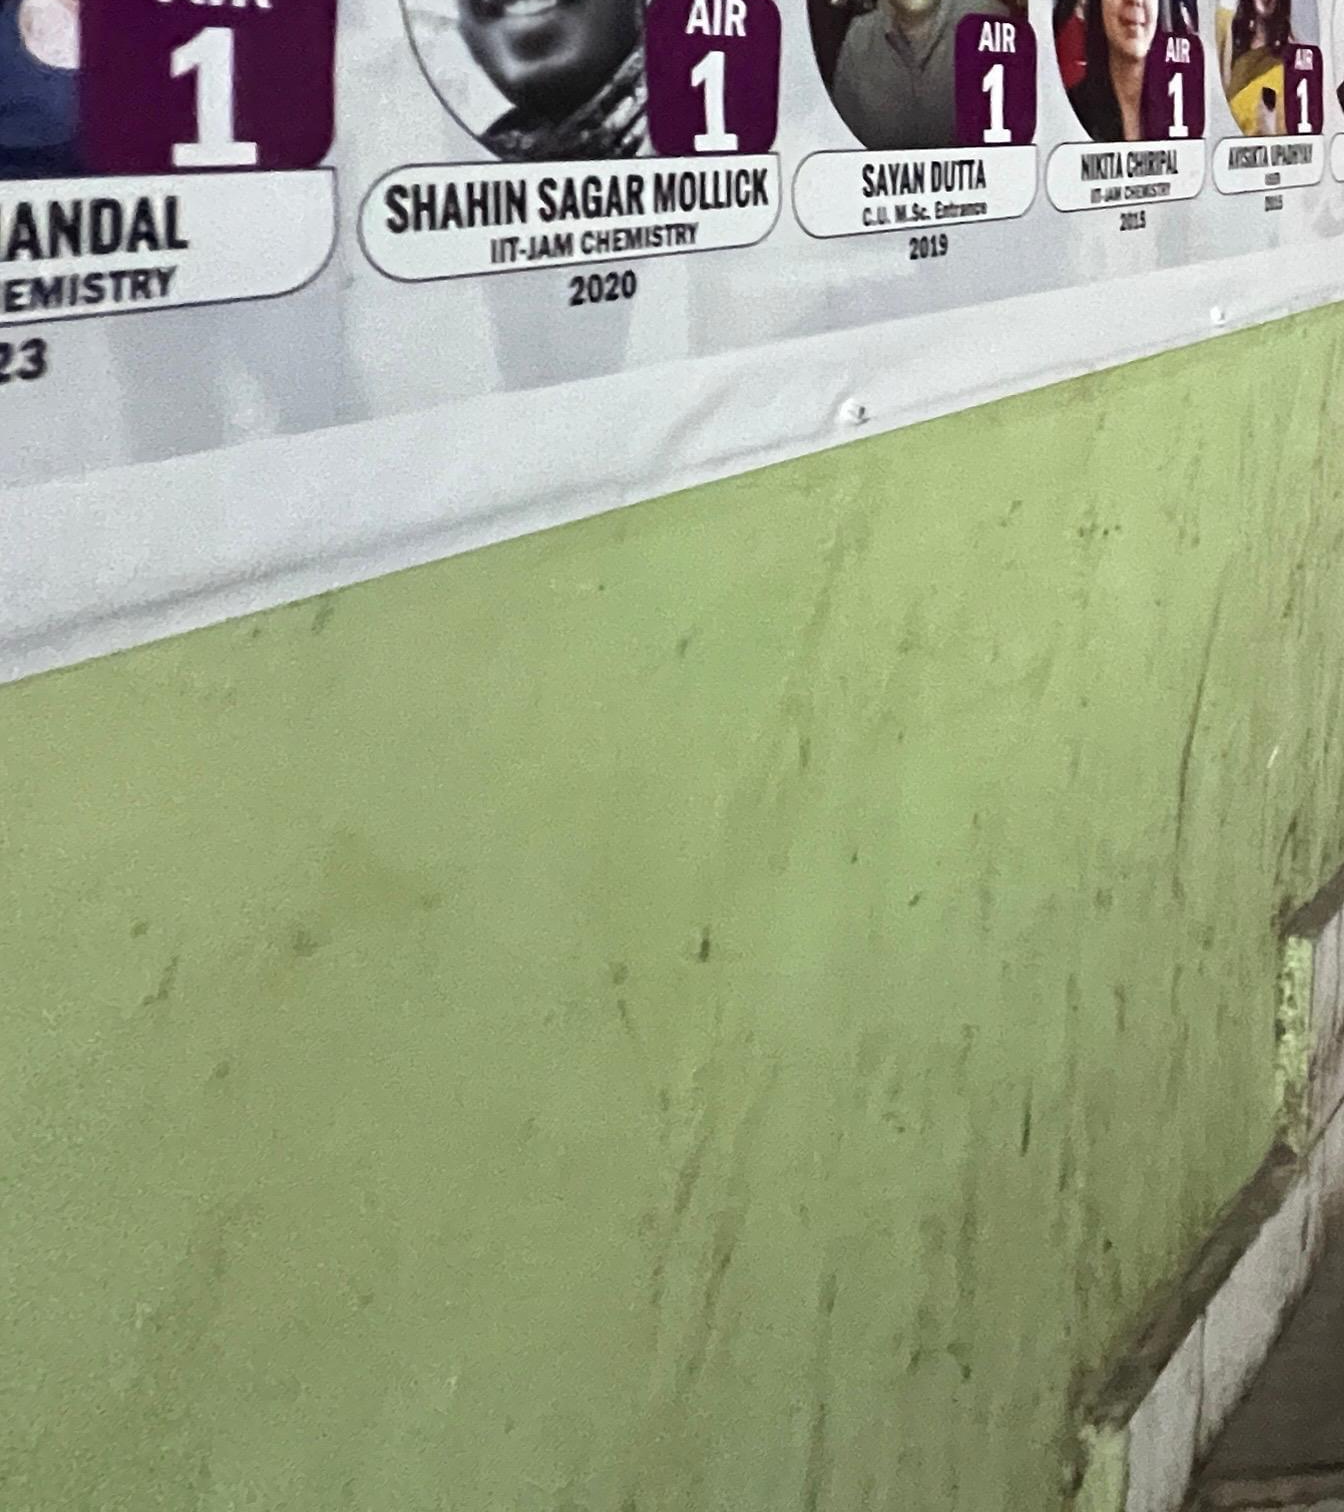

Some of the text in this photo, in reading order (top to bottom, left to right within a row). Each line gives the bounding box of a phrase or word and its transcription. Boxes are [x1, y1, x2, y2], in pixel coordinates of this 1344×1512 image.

[978, 20, 1017, 54] AIR
[1165, 36, 1192, 65] AIR
[169, 27, 260, 168] 1
[688, 50, 740, 153] 1
[981, 62, 1013, 145] 1
[1166, 71, 1190, 138] 1
[1296, 77, 1314, 134] 1
[384, 168, 770, 236] SHAHIN SAGAR MOLLICK
[861, 158, 988, 199] SAYAN DUTTA
[0, 195, 189, 263] ANDAL
[489, 222, 700, 266] IIT-JAM CHEMISTRY
[908, 232, 949, 261] 2019
[568, 270, 638, 307] 2020
